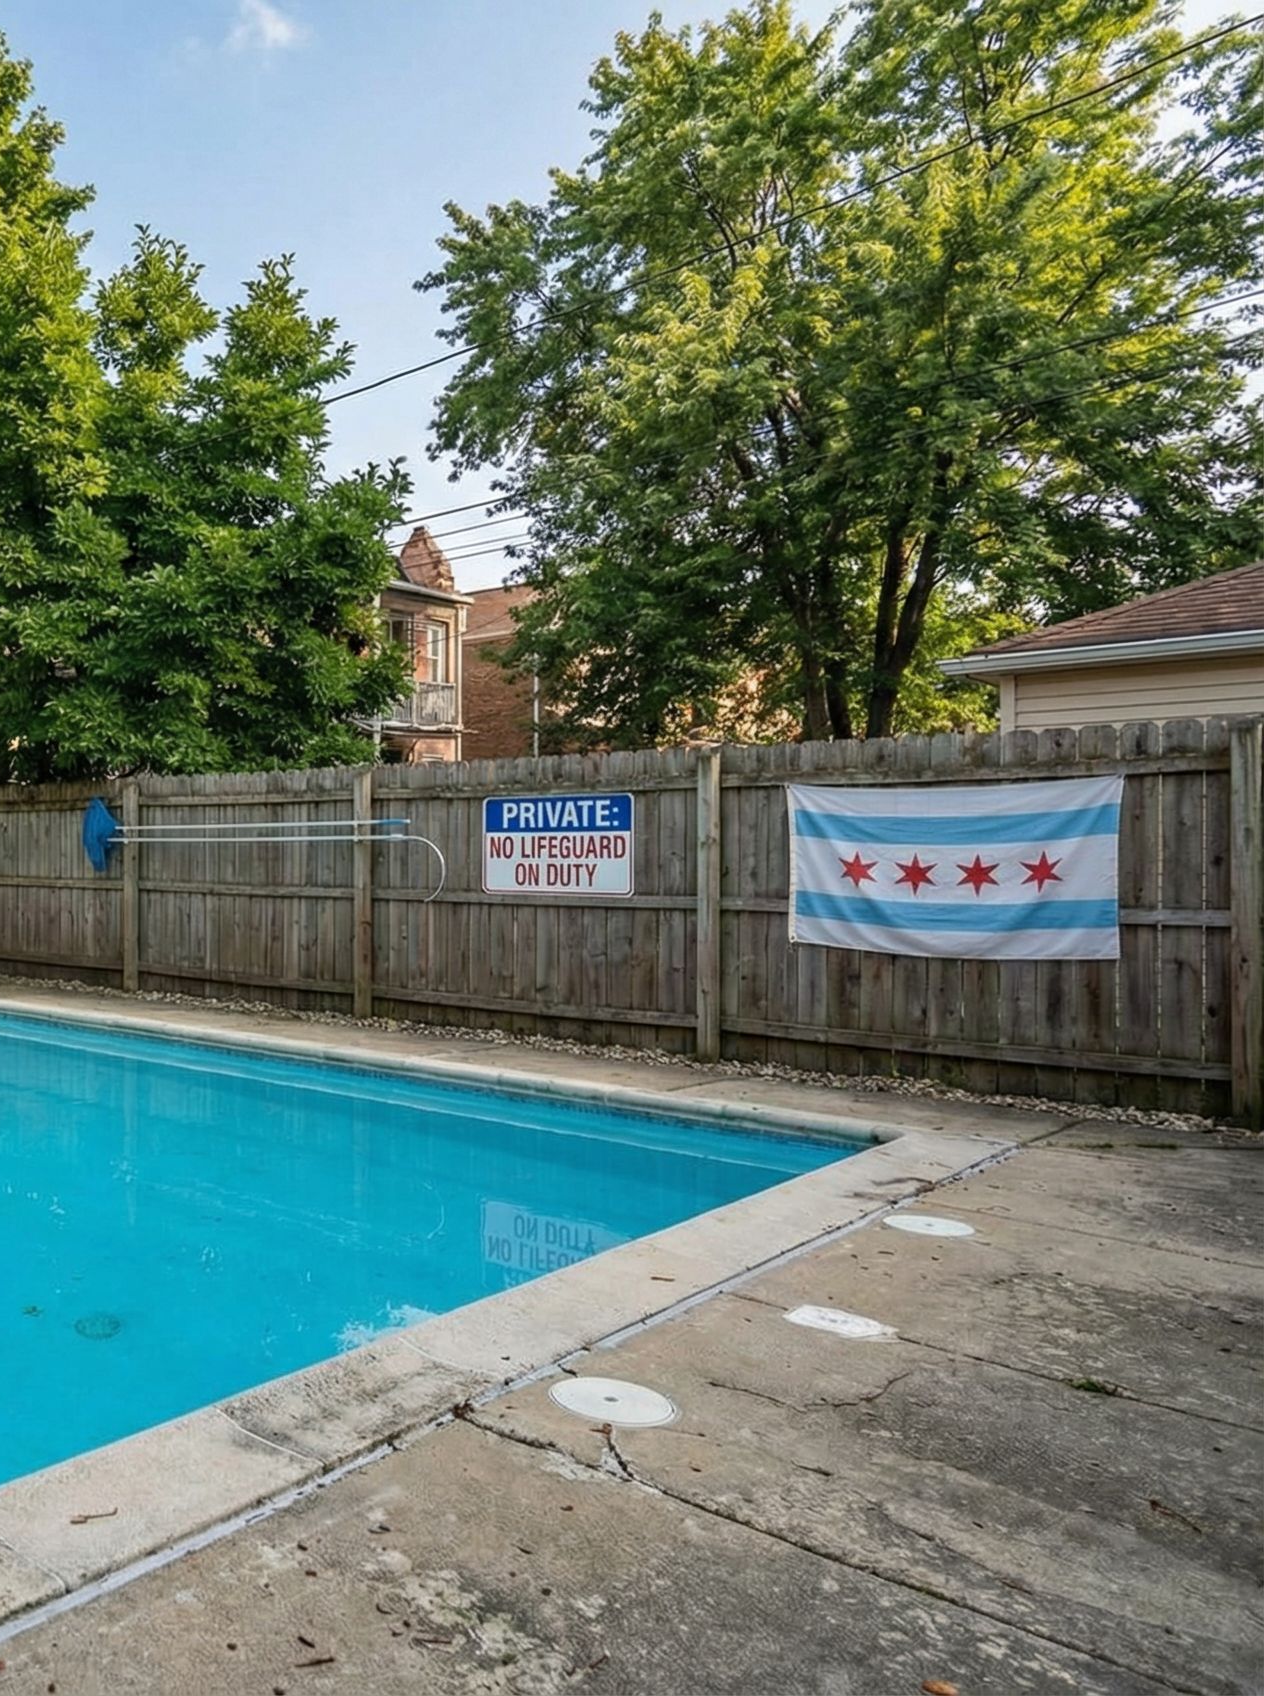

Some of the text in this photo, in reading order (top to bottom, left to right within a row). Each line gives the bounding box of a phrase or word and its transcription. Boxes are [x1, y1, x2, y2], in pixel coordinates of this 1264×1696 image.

[502, 799, 619, 829] PRIVATE:
[490, 835, 626, 859] NO LIFEGUARD
[515, 863, 598, 887] ON DUTY
